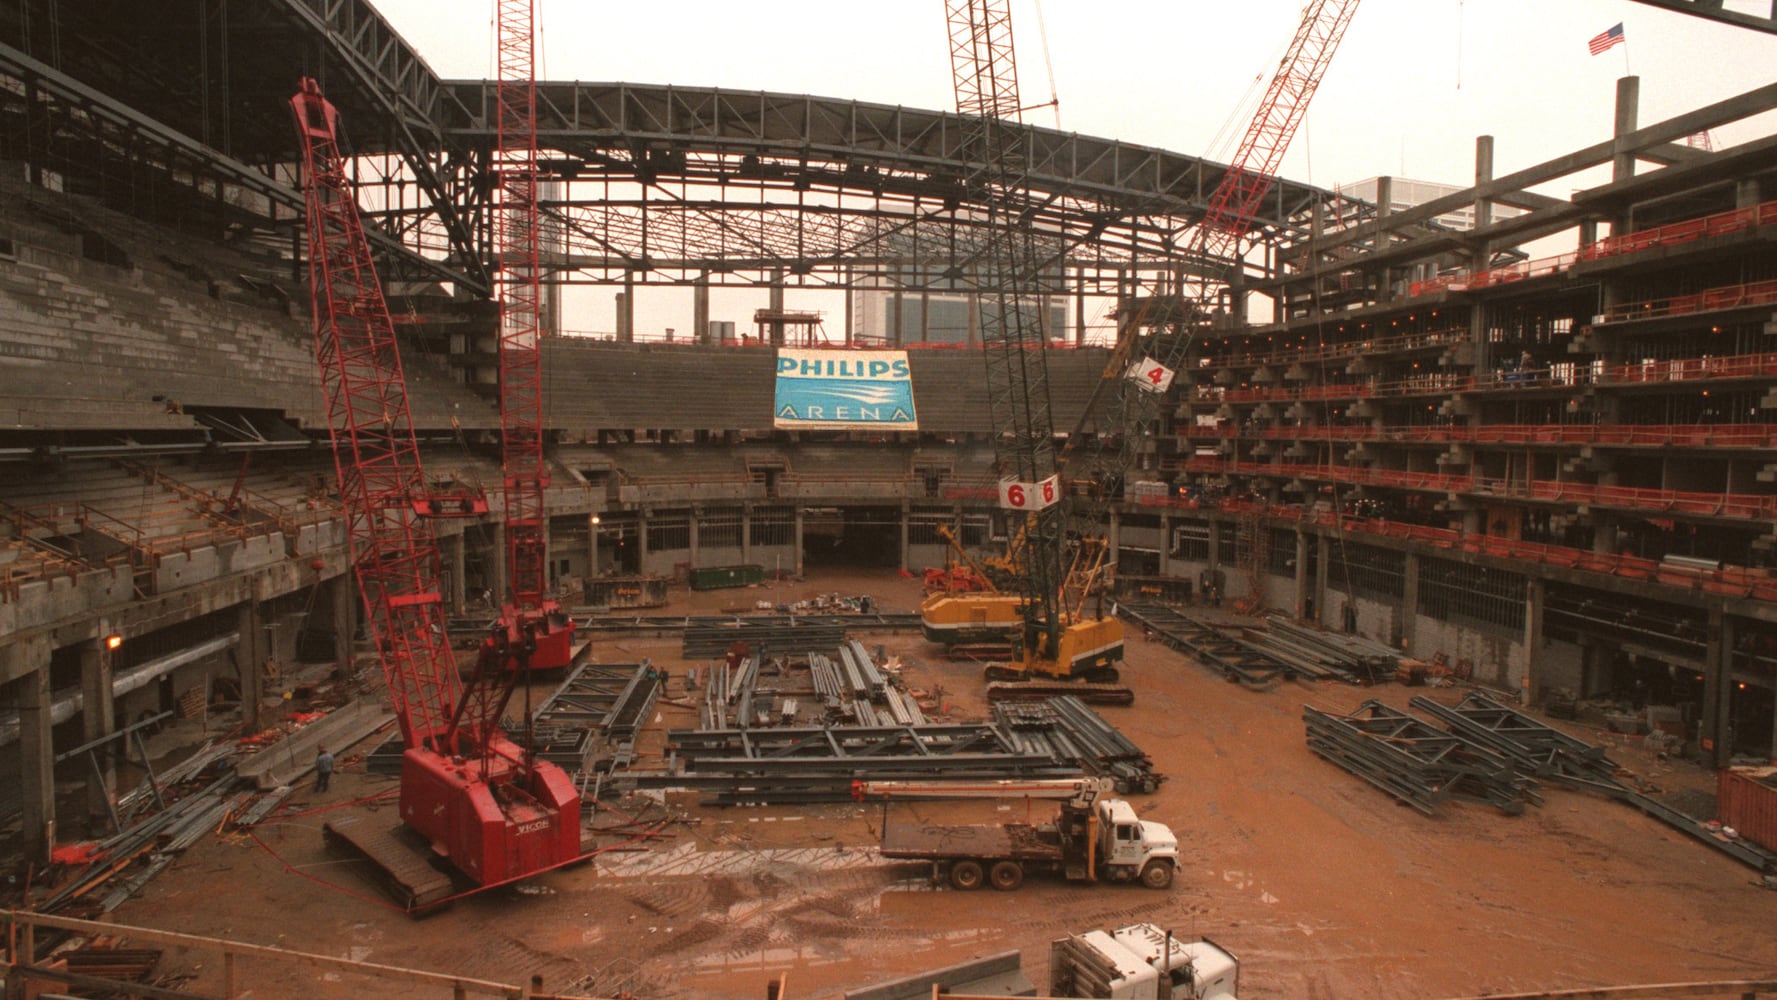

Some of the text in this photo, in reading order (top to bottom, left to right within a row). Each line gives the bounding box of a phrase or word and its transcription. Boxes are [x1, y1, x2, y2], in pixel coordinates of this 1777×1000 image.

[777, 357, 909, 378] PHILIPS
[1147, 367, 1164, 385] 4
[779, 404, 911, 421] ARENA
[1008, 484, 1025, 507] 6
[1043, 480, 1054, 504] 6
